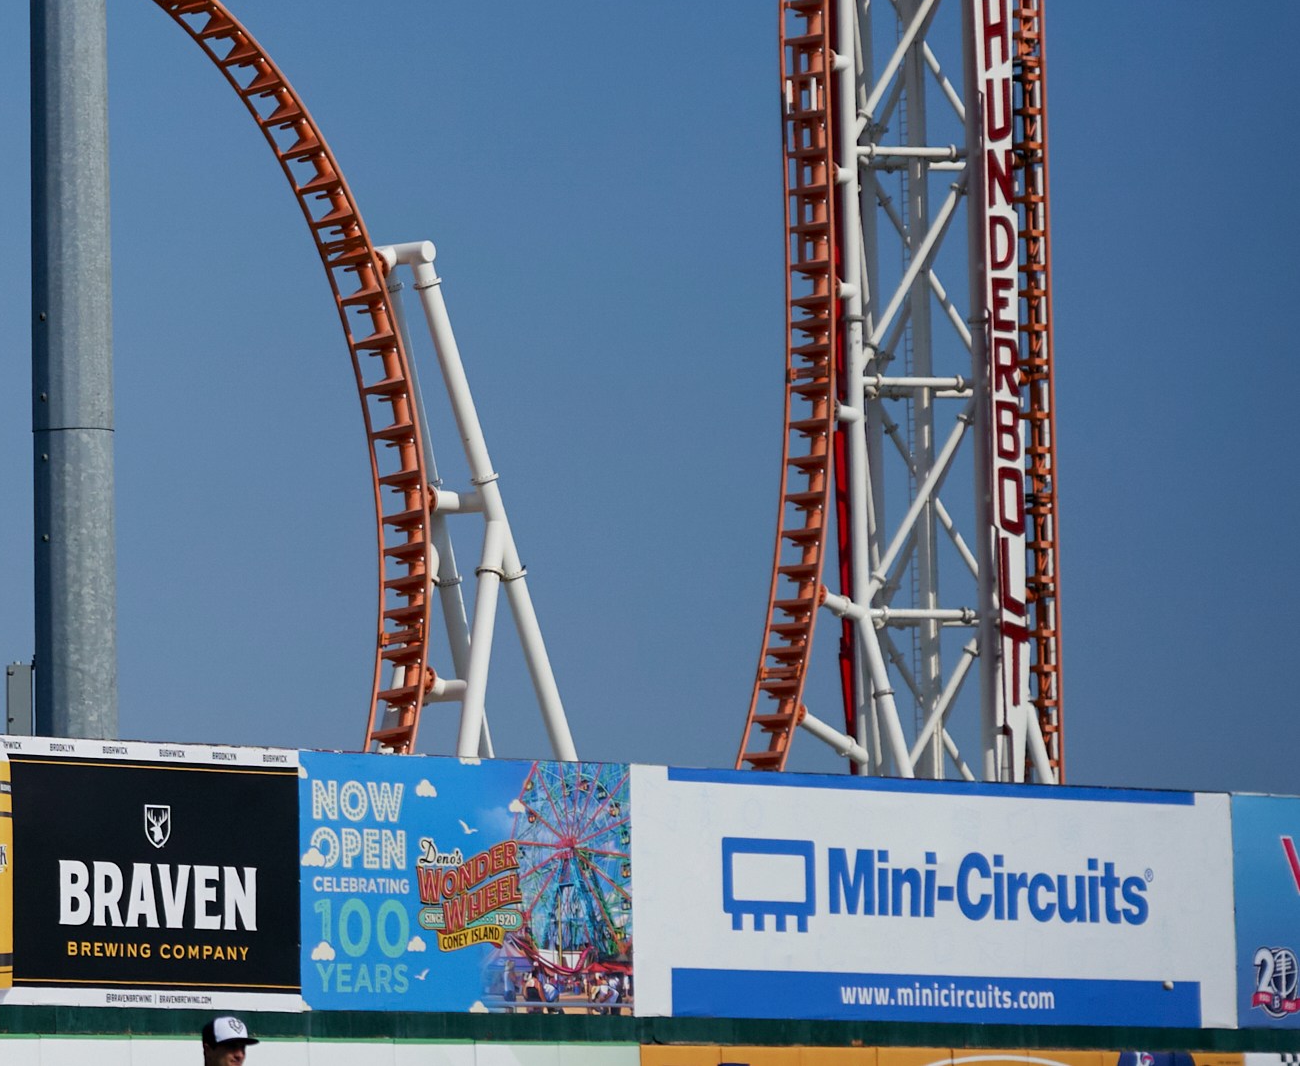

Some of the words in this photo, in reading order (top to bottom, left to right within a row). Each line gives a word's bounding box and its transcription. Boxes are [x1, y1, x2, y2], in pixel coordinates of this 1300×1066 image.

[50, 743, 75, 752] BROOKLYN
[102, 746, 128, 755] BUSHWICK
[159, 749, 185, 758] BUSHWICK
[212, 752, 236, 761] BROOKLYN
[263, 754, 287, 763] BUSHWICK
[312, 780, 404, 822] NOW
[310, 827, 406, 870] OPEN
[419, 839, 462, 864] Deno's
[313, 876, 409, 894] CELEBRATING
[416, 841, 519, 905] WONDER
[58, 859, 258, 931] BRAVEN
[828, 847, 1148, 926] Mini-Circuits
[443, 874, 522, 933] WHEEL
[314, 898, 409, 958] 100
[495, 914, 516, 925] 1920
[67, 941, 151, 958] BREWING
[160, 943, 249, 961] COMPANY
[442, 935, 469, 950] CONEY
[472, 927, 500, 942] ISLAND
[316, 963, 409, 993] YEARS
[840, 984, 1055, 1010] www.minicircuits.com
